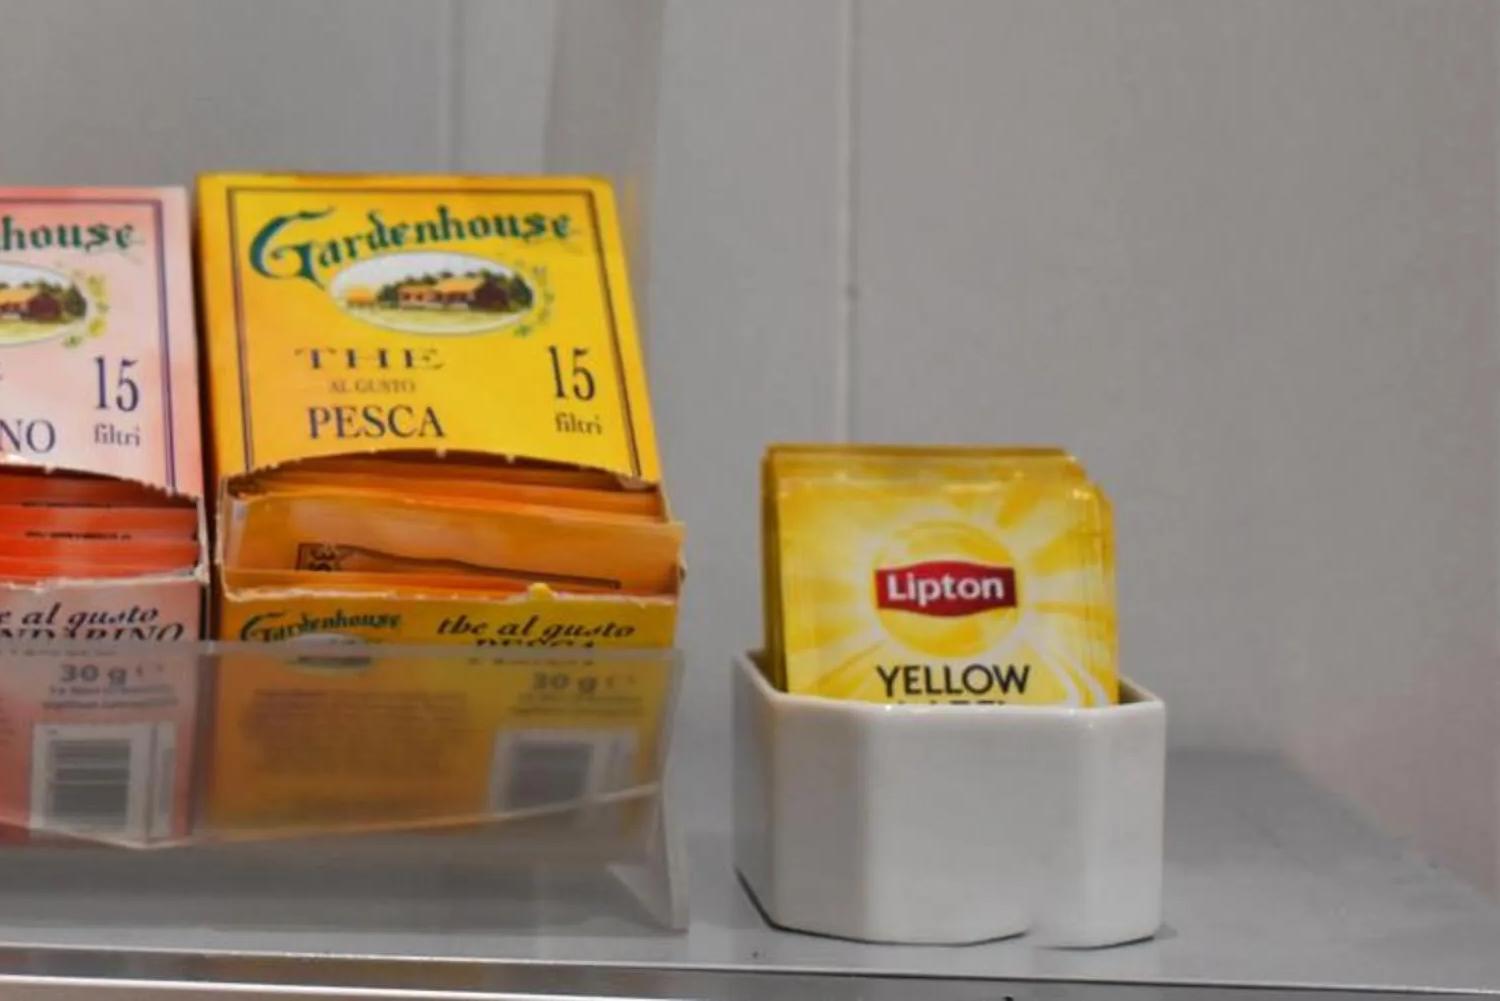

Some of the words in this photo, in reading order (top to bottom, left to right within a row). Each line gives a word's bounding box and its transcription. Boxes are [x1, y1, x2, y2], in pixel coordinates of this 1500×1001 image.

[249, 205, 573, 291] Gardenhouse
[295, 346, 445, 370] THE
[93, 356, 140, 413] 15
[329, 379, 350, 394] AL
[355, 378, 416, 394] GUSTO
[549, 345, 596, 401] 15
[94, 422, 141, 448] filtri
[308, 404, 446, 439] PESCA
[554, 411, 603, 437] filtri
[887, 572, 1005, 607] Lipton
[22, 602, 62, 625] al
[68, 605, 159, 630] gusto
[497, 615, 539, 636] al
[543, 621, 635, 640] gusto
[60, 663, 100, 683] 30
[107, 667, 127, 687] g
[876, 663, 1030, 697] YELLOW
